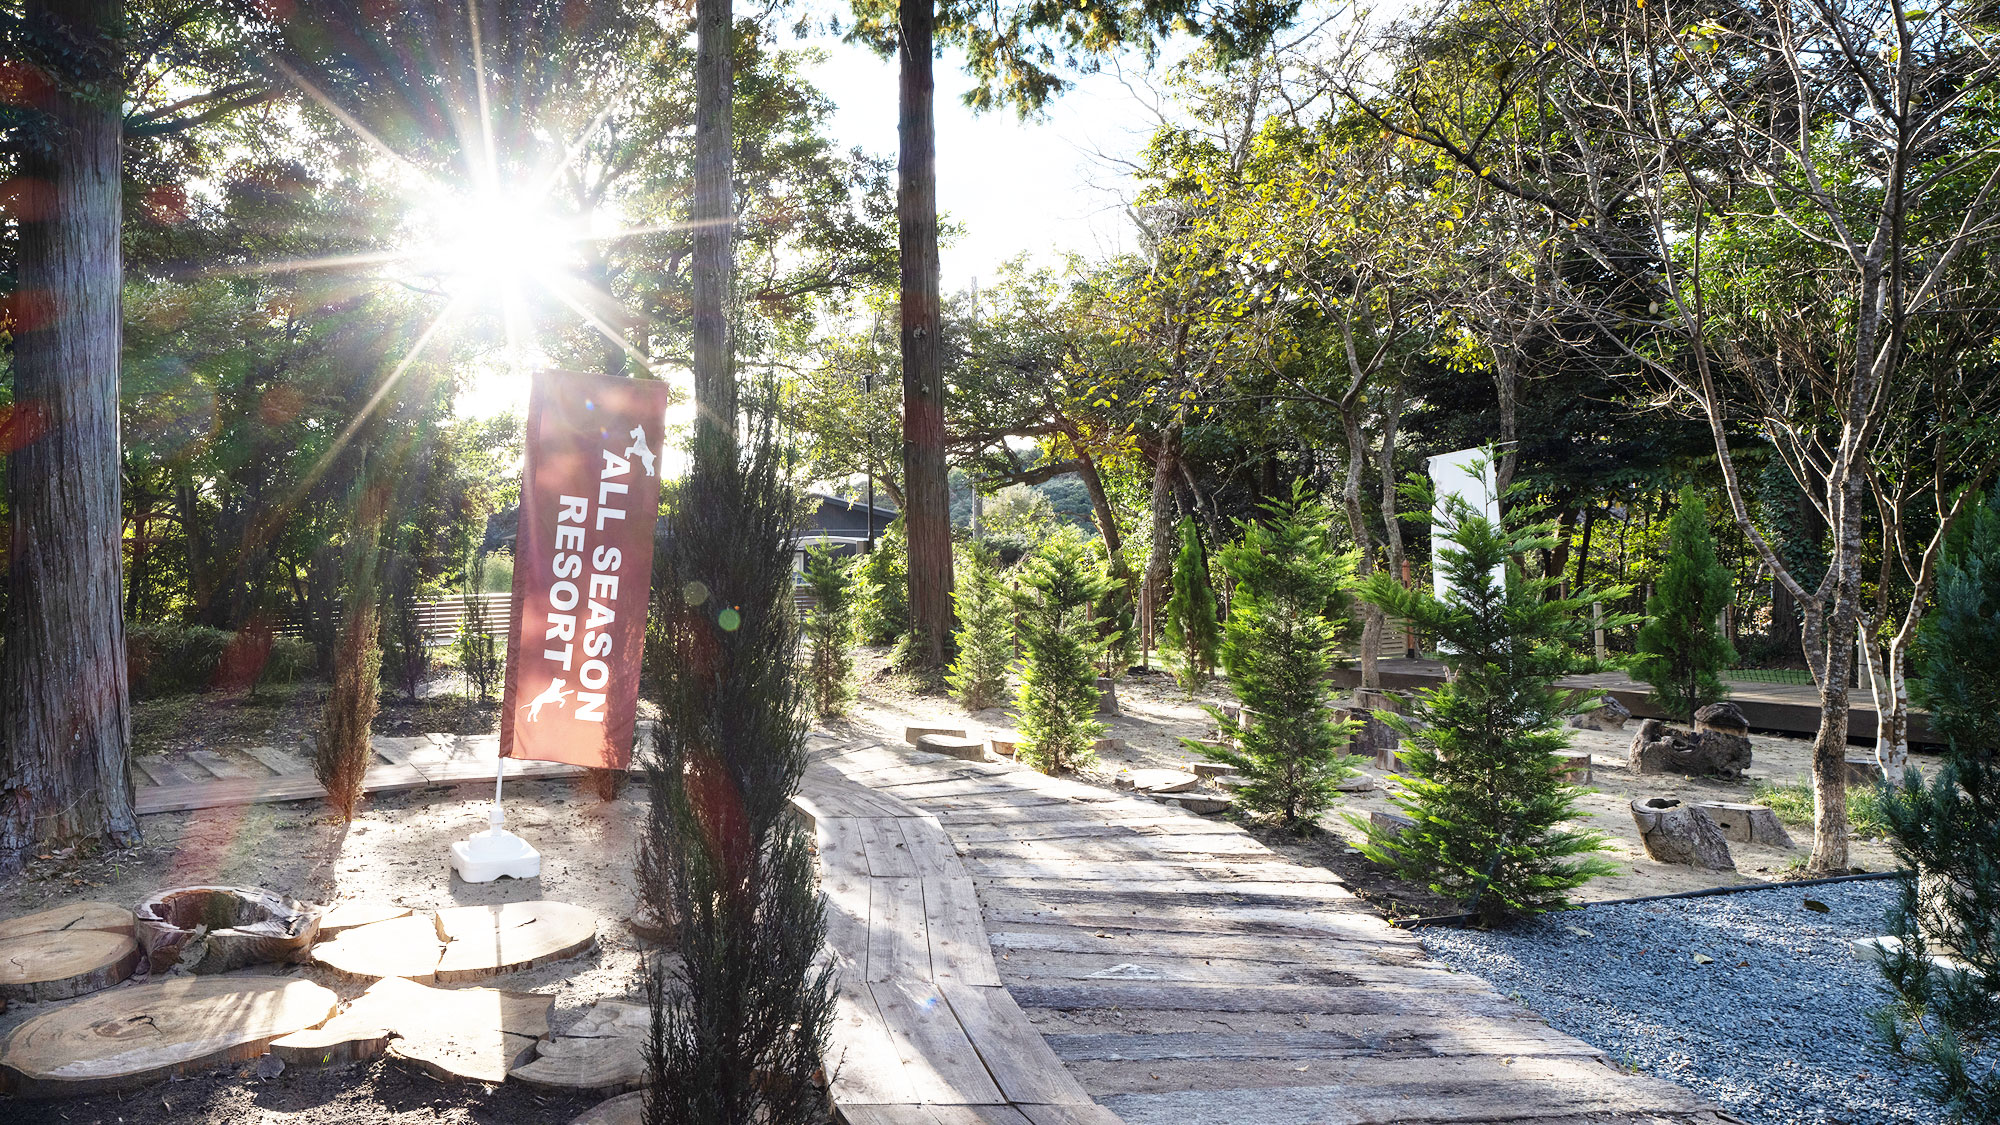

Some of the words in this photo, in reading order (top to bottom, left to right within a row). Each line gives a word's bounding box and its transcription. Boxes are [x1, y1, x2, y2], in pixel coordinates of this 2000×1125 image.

[596, 449, 630, 530] ALL
[543, 495, 589, 671] RESORT
[574, 545, 622, 722] SEASON
